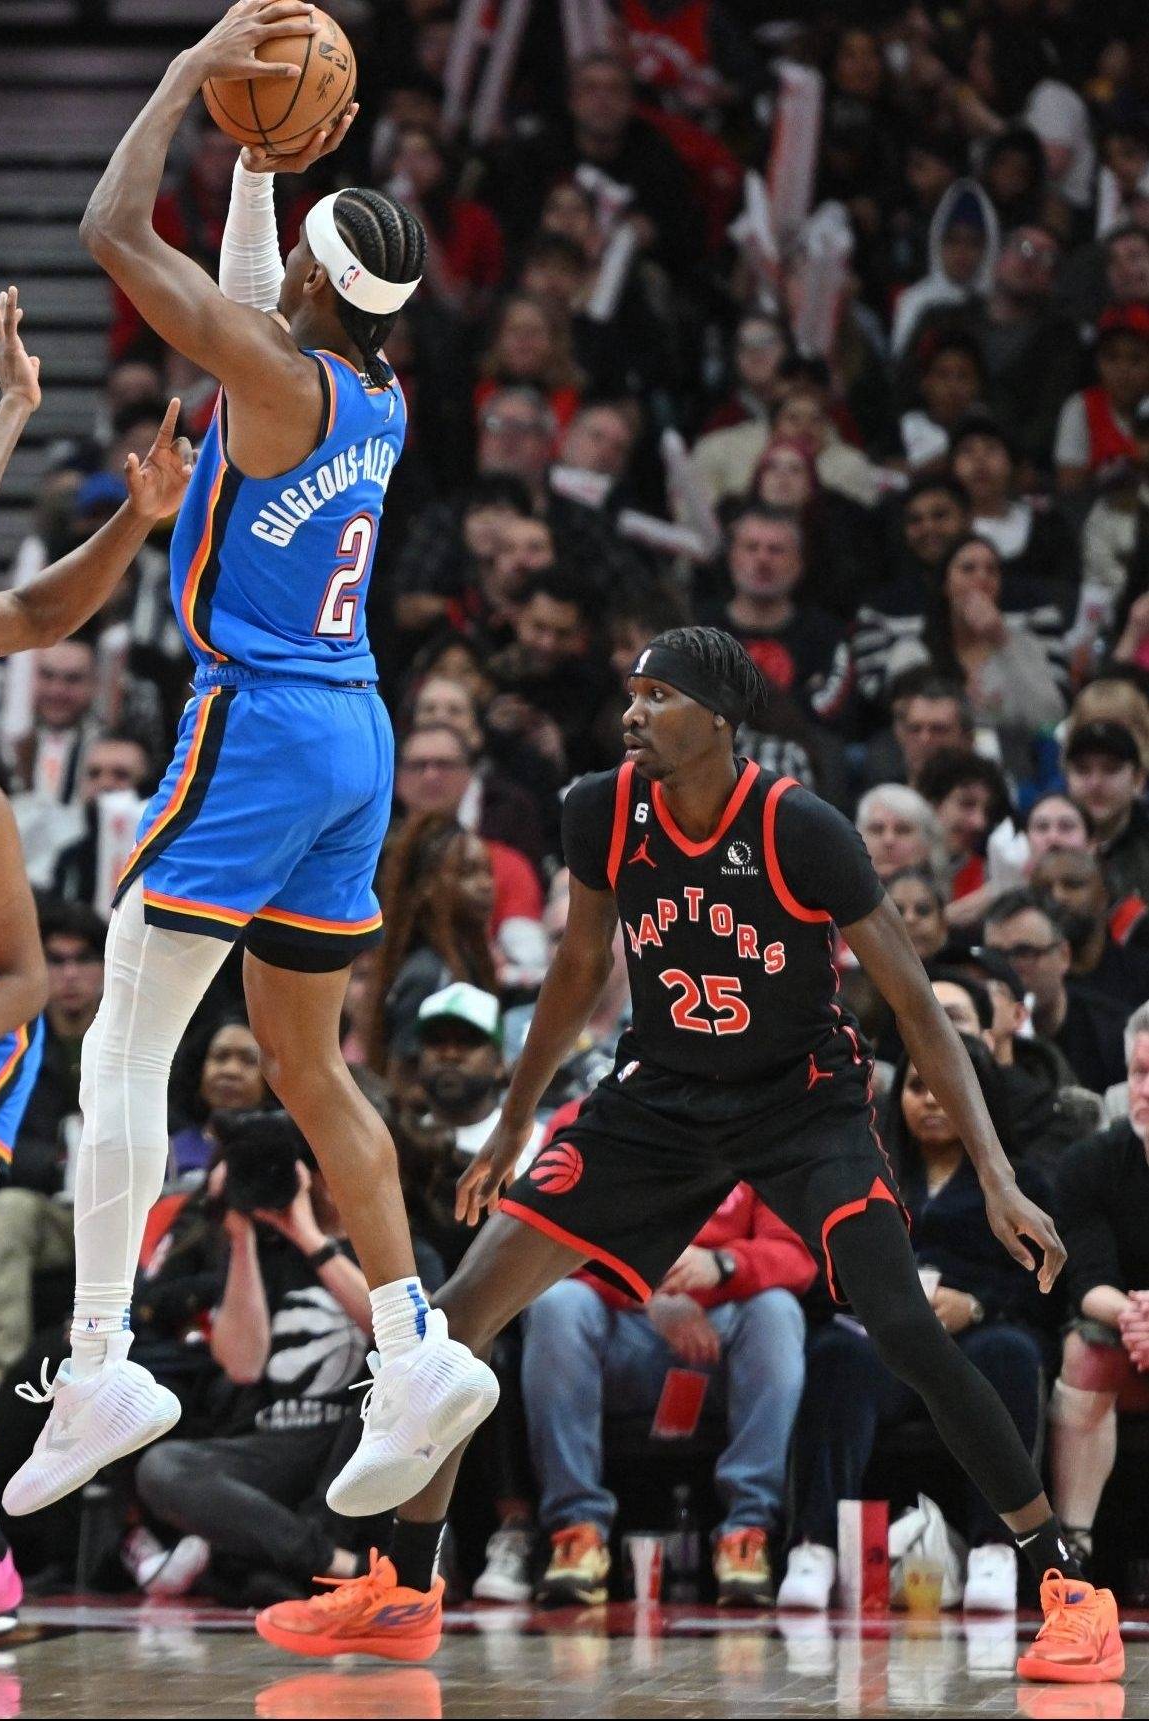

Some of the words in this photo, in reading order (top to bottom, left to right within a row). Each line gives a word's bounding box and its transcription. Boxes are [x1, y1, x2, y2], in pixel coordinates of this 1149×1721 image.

[313, 511, 376, 640] 2
[635, 802, 649, 823] 6
[721, 865, 740, 875] Sun
[741, 865, 759, 875] Life
[658, 968, 750, 1036] 25
